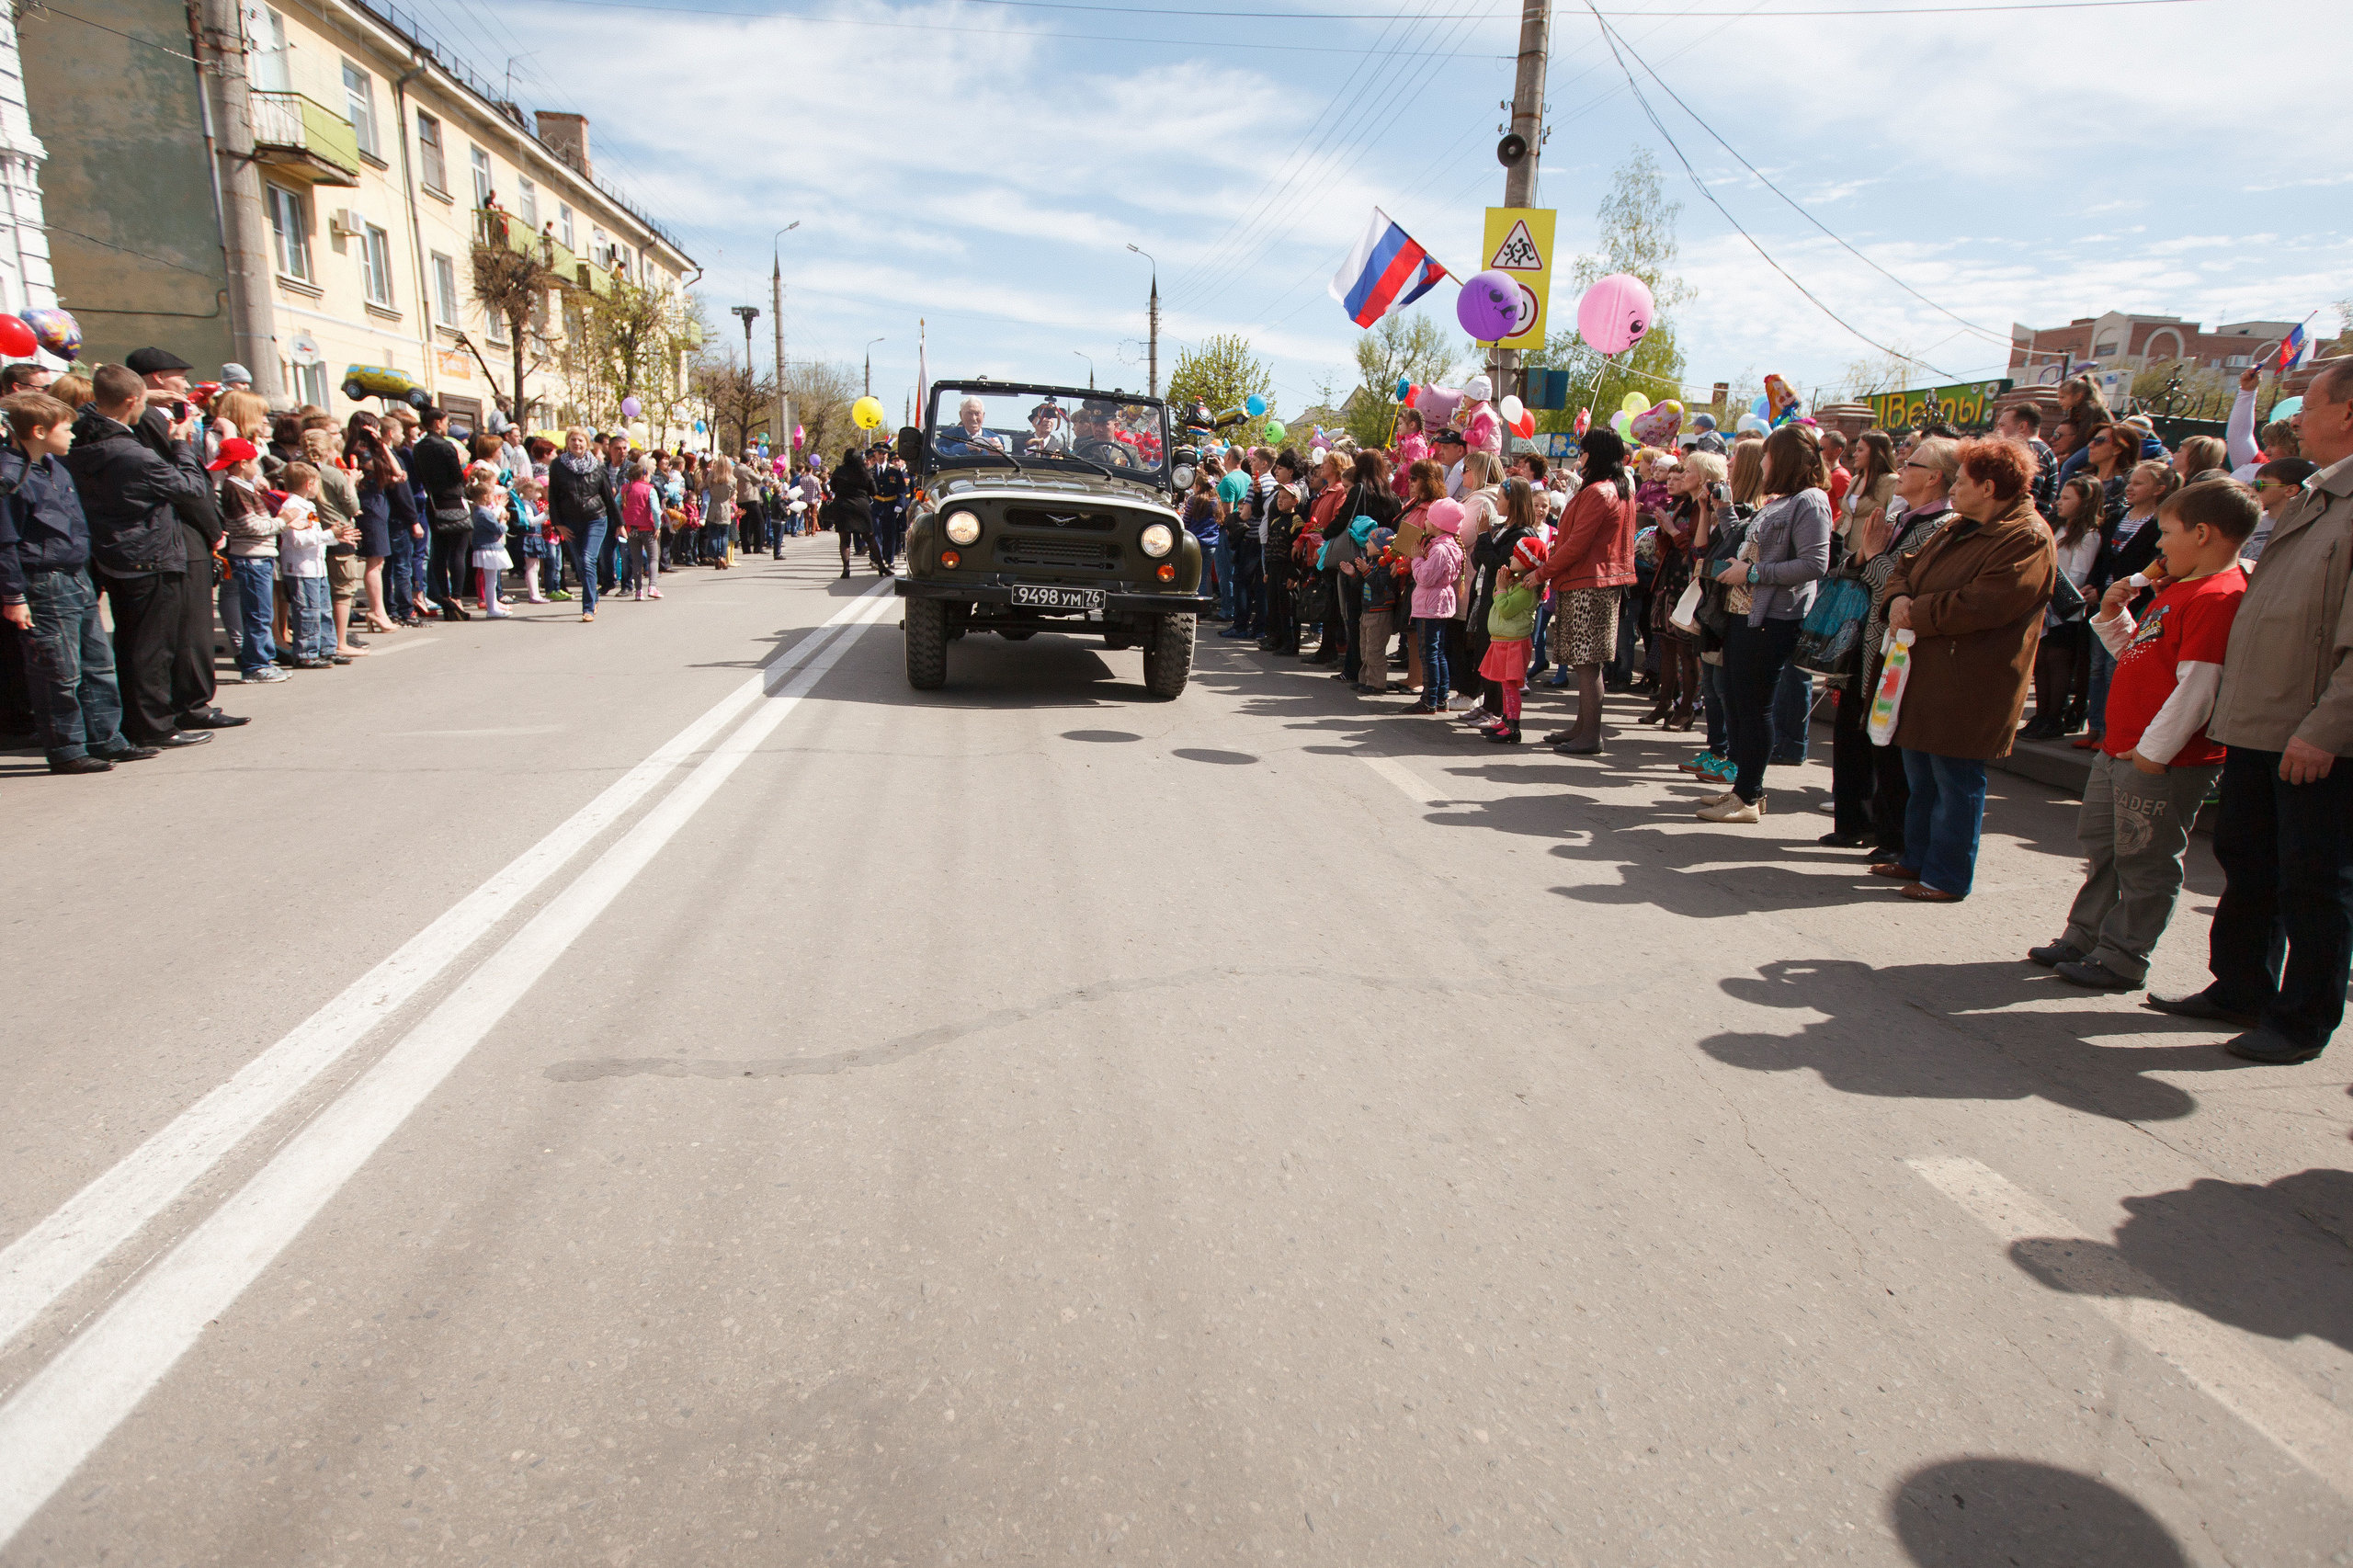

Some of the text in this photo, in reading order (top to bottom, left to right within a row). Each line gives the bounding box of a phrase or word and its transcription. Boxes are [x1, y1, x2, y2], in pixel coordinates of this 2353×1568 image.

[1018, 587, 1059, 605] 9498
[1085, 591, 1100, 603] 76
[2113, 785, 2167, 816] EADER
